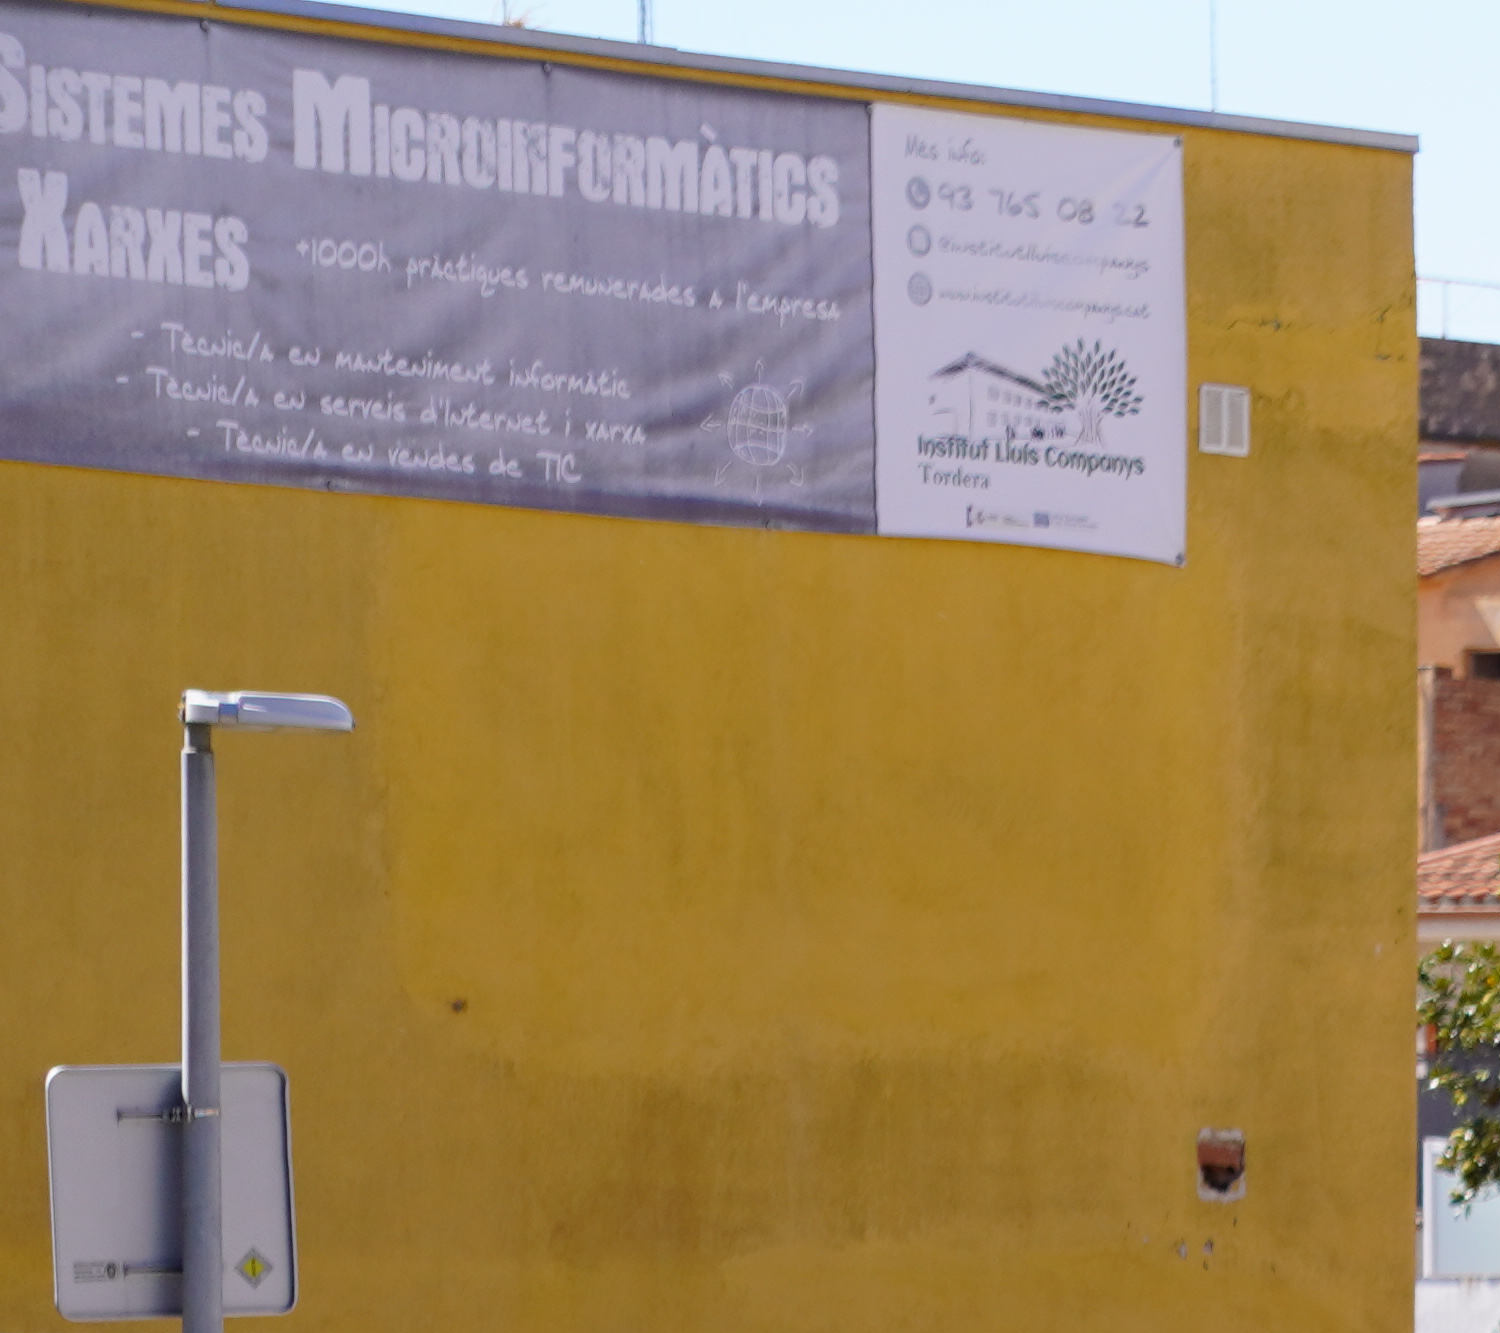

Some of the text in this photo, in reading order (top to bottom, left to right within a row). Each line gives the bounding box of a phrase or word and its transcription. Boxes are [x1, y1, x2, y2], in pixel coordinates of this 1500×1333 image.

[0, 32, 841, 229] SISTEMES MICROINFORMÀTICS
[938, 182, 974, 212] 93
[988, 187, 1041, 219] 765
[1056, 196, 1095, 225] 08
[18, 168, 250, 291] XARXES
[295, 238, 392, 273] +1000h
[489, 448, 524, 479] de
[536, 451, 583, 484] TIC
[917, 435, 990, 462] Institut
[1044, 447, 1146, 480] Companys
[917, 462, 990, 490] Tordera
